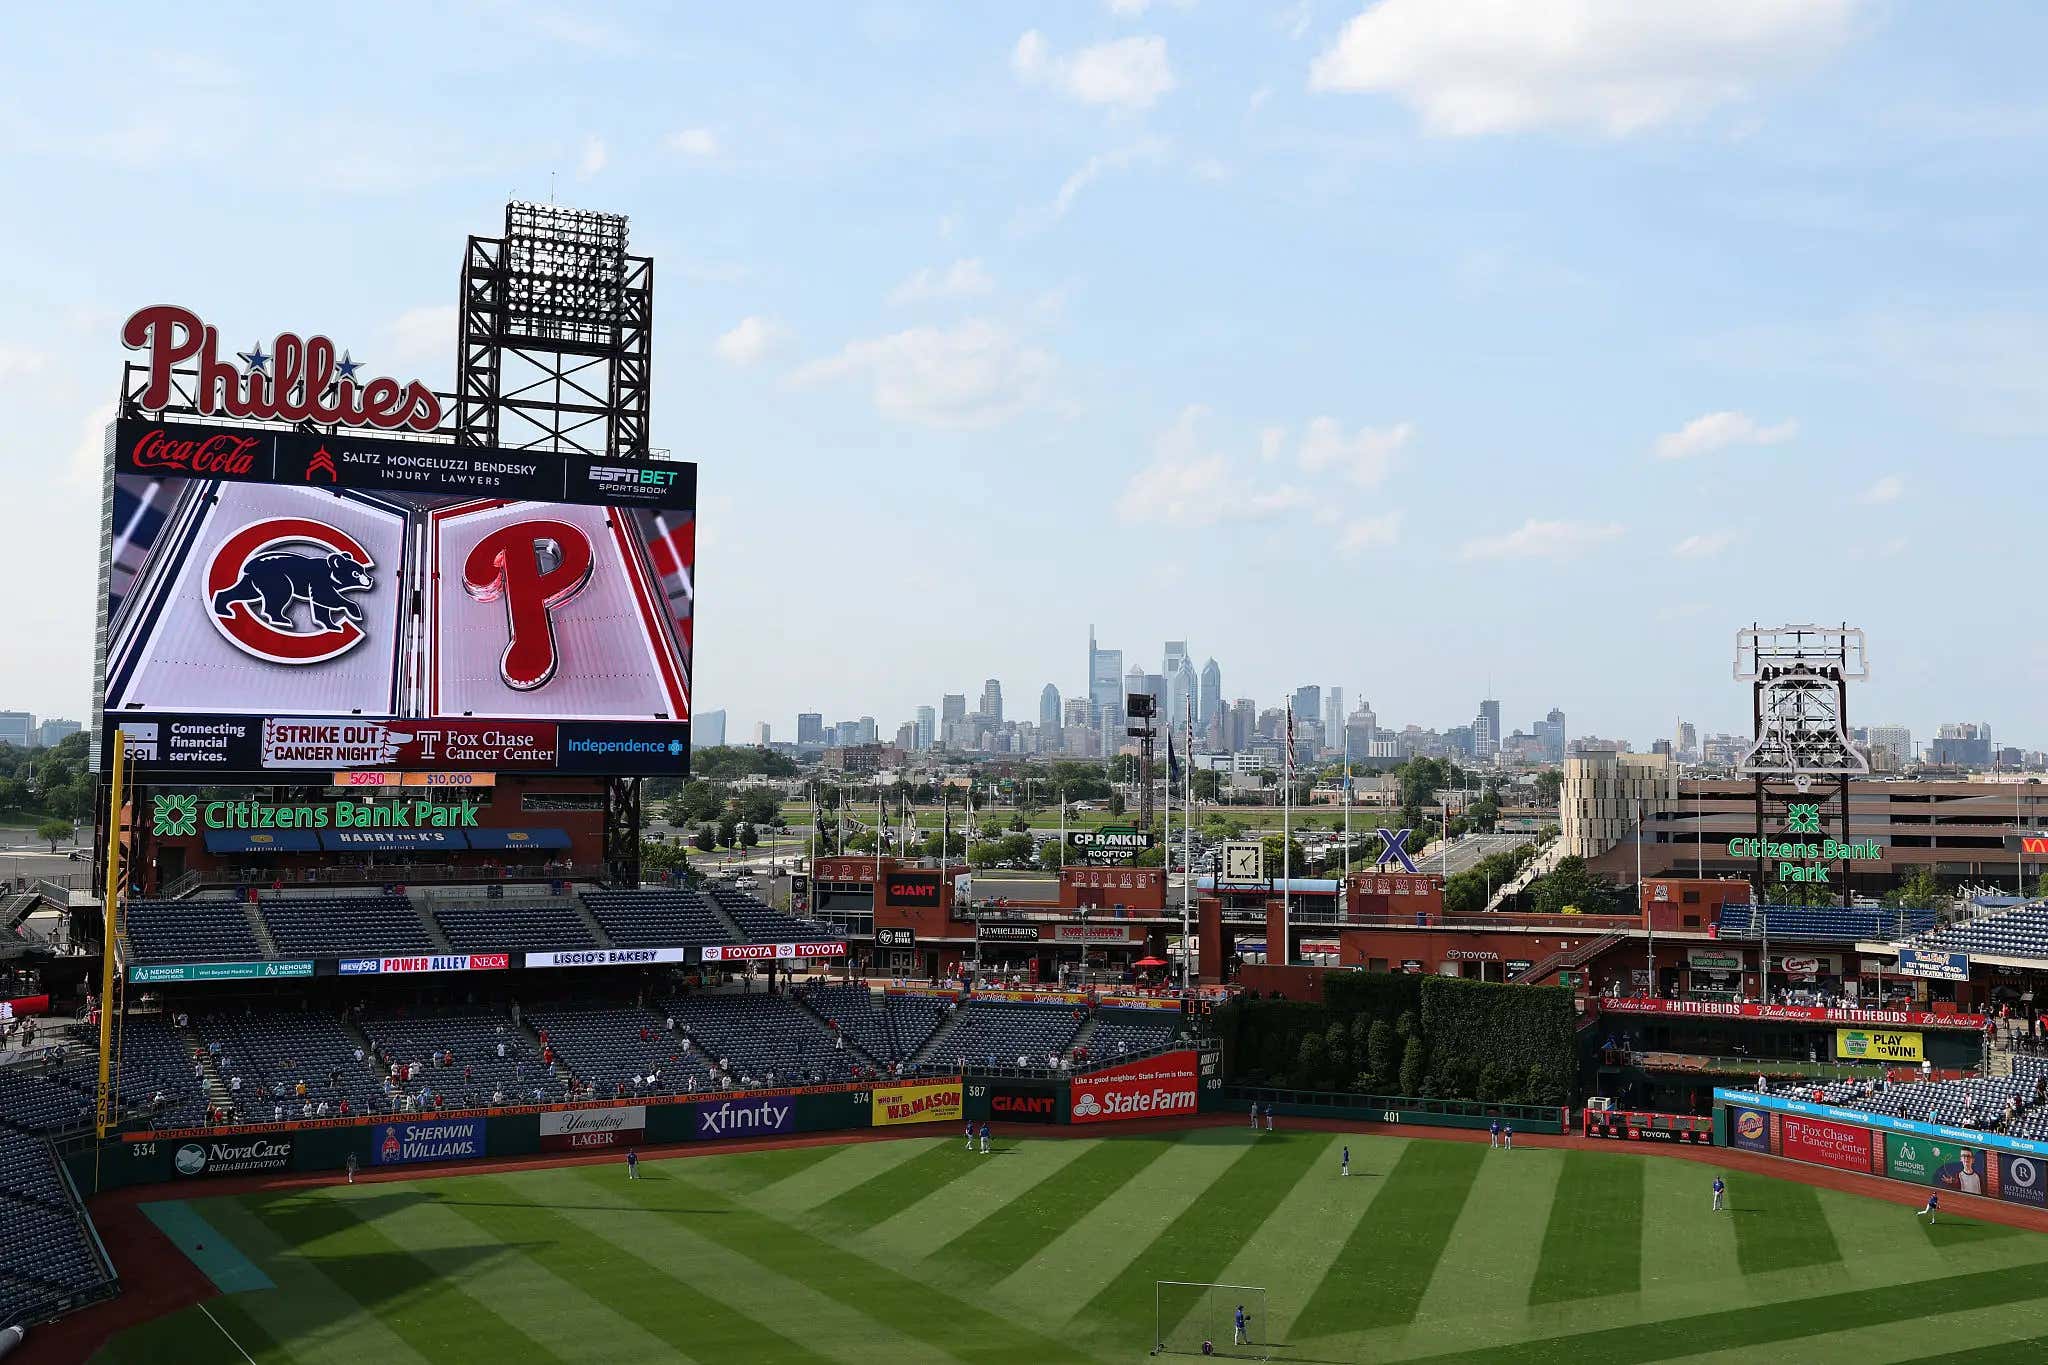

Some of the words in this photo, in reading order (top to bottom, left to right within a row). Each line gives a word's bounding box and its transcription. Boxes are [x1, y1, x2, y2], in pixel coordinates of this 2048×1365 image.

[121, 304, 442, 430] Phillies
[132, 428, 261, 475] Coca-Cola
[342, 451, 381, 465] SALTZ
[387, 454, 469, 471] MONGELUZZI
[474, 461, 537, 476] BENDESKY
[381, 469, 431, 482] INJURY
[441, 473, 502, 486] LAWYERS
[598, 483, 668, 495] SPORTSBOOK
[171, 722, 246, 738] Connecting
[275, 726, 339, 744] STRIKE
[344, 726, 380, 744] OUT
[171, 736, 227, 748] financial
[446, 730, 479, 746] Fox
[482, 731, 534, 746] Chase
[568, 738, 665, 754] Independence
[169, 750, 227, 762] services.
[274, 746, 333, 761] CANCER
[337, 746, 378, 761] NIGHT
[445, 747, 500, 760] Cancer
[503, 748, 554, 761] Center
[427, 774, 473, 786] $10,000
[204, 801, 329, 829] Citizens
[335, 801, 410, 829] Bank
[415, 800, 479, 827] Park
[340, 833, 395, 843] HARRY
[420, 832, 445, 842] K'S
[1074, 834, 1094, 845] CP
[1088, 850, 1133, 858] ROOFTOP
[1728, 837, 1818, 860] Citizens
[1823, 839, 1881, 861] Bank
[1779, 862, 1830, 883] Park
[890, 885, 936, 897] GIANT
[554, 952, 605, 964] LISCIO'S
[609, 950, 657, 963] BAKERY
[726, 947, 772, 958] TOYOTA
[799, 944, 845, 956] TOYOTA
[1461, 951, 1499, 960] TOYOTA
[383, 957, 429, 972] POWER
[432, 956, 467, 970] ALLEY
[473, 956, 506, 968] NECA
[1604, 998, 1657, 1011] Budweiser
[1665, 1000, 1741, 1015] #HITTHEBUDS
[1757, 1005, 1812, 1019] Budweiser
[1873, 1034, 1903, 1046] PLAY
[1887, 1046, 1916, 1057] WIN!
[1075, 1077, 1088, 1085] Like
[1094, 1076, 1109, 1085] good
[1110, 1074, 1137, 1083] neighbor,
[1155, 1071, 1171, 1079] Farm
[1206, 1078, 1222, 1090] 409
[853, 1092, 870, 1104] 374
[968, 1085, 986, 1097] 387
[992, 1098, 1055, 1113] GIANT
[560, 1112, 627, 1134] Yuengling
[702, 1101, 789, 1134] xfinity
[1383, 1111, 1400, 1123] 401
[404, 1124, 474, 1142] SHERWIN
[571, 1132, 614, 1147] LAGER
[1641, 1130, 1671, 1139] TOYOTA
[1802, 1125, 1820, 1138] Fox
[1823, 1126, 1855, 1143] Chase
[133, 1143, 156, 1157] 334
[208, 1141, 291, 1161] NovaCare
[1801, 1136, 1834, 1151] Cancer
[1836, 1141, 1867, 1155] Center
[1821, 1149, 1846, 1163] Temple
[1846, 1152, 1868, 1165] Health
[208, 1160, 287, 1172] REHABILITATION
[1894, 1160, 1925, 1171] NEMOURS
[2003, 1184, 2044, 1198] ROTHMAN
